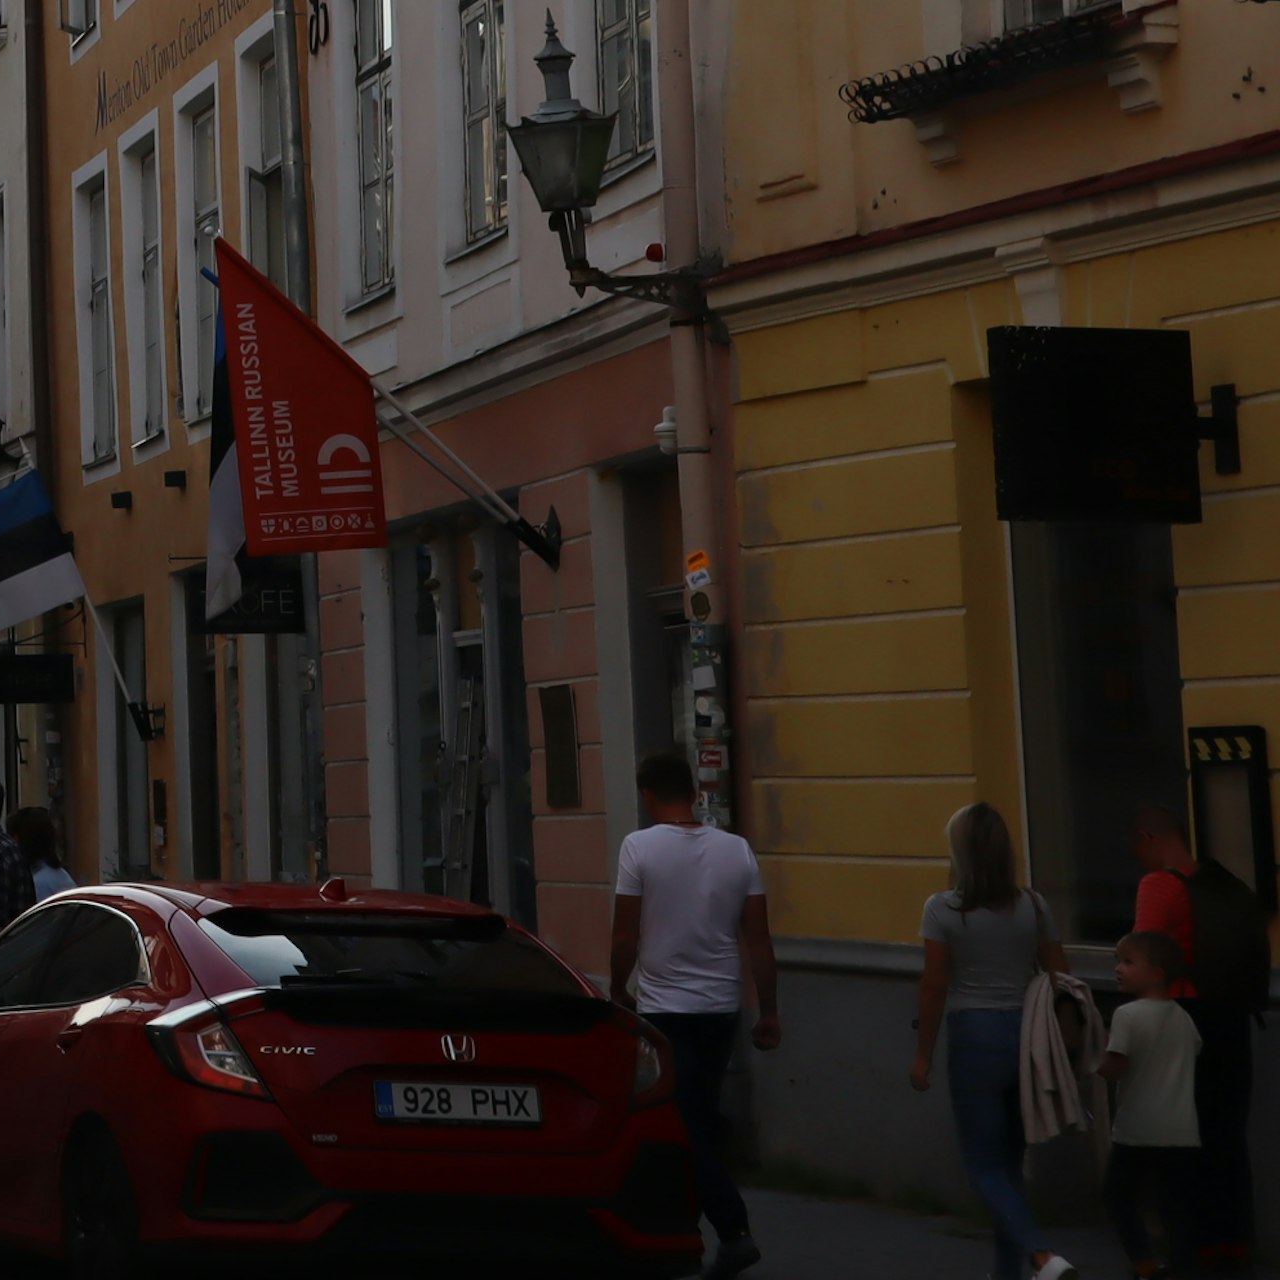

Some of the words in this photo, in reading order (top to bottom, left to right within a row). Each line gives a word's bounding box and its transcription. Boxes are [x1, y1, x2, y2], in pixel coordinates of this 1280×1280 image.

[95, 66, 133, 137] Meriton
[133, 51, 151, 101] Old
[151, 43, 178, 85] Town
[178, 3, 216, 61] Garden
[236, 303, 263, 400] RUSSIAN
[247, 407, 275, 500] TALLINN
[271, 400, 300, 498] MUSEUM
[259, 1046, 317, 1055] CIVIC
[402, 1086, 453, 1115] 928
[471, 1088, 532, 1118] PHX
